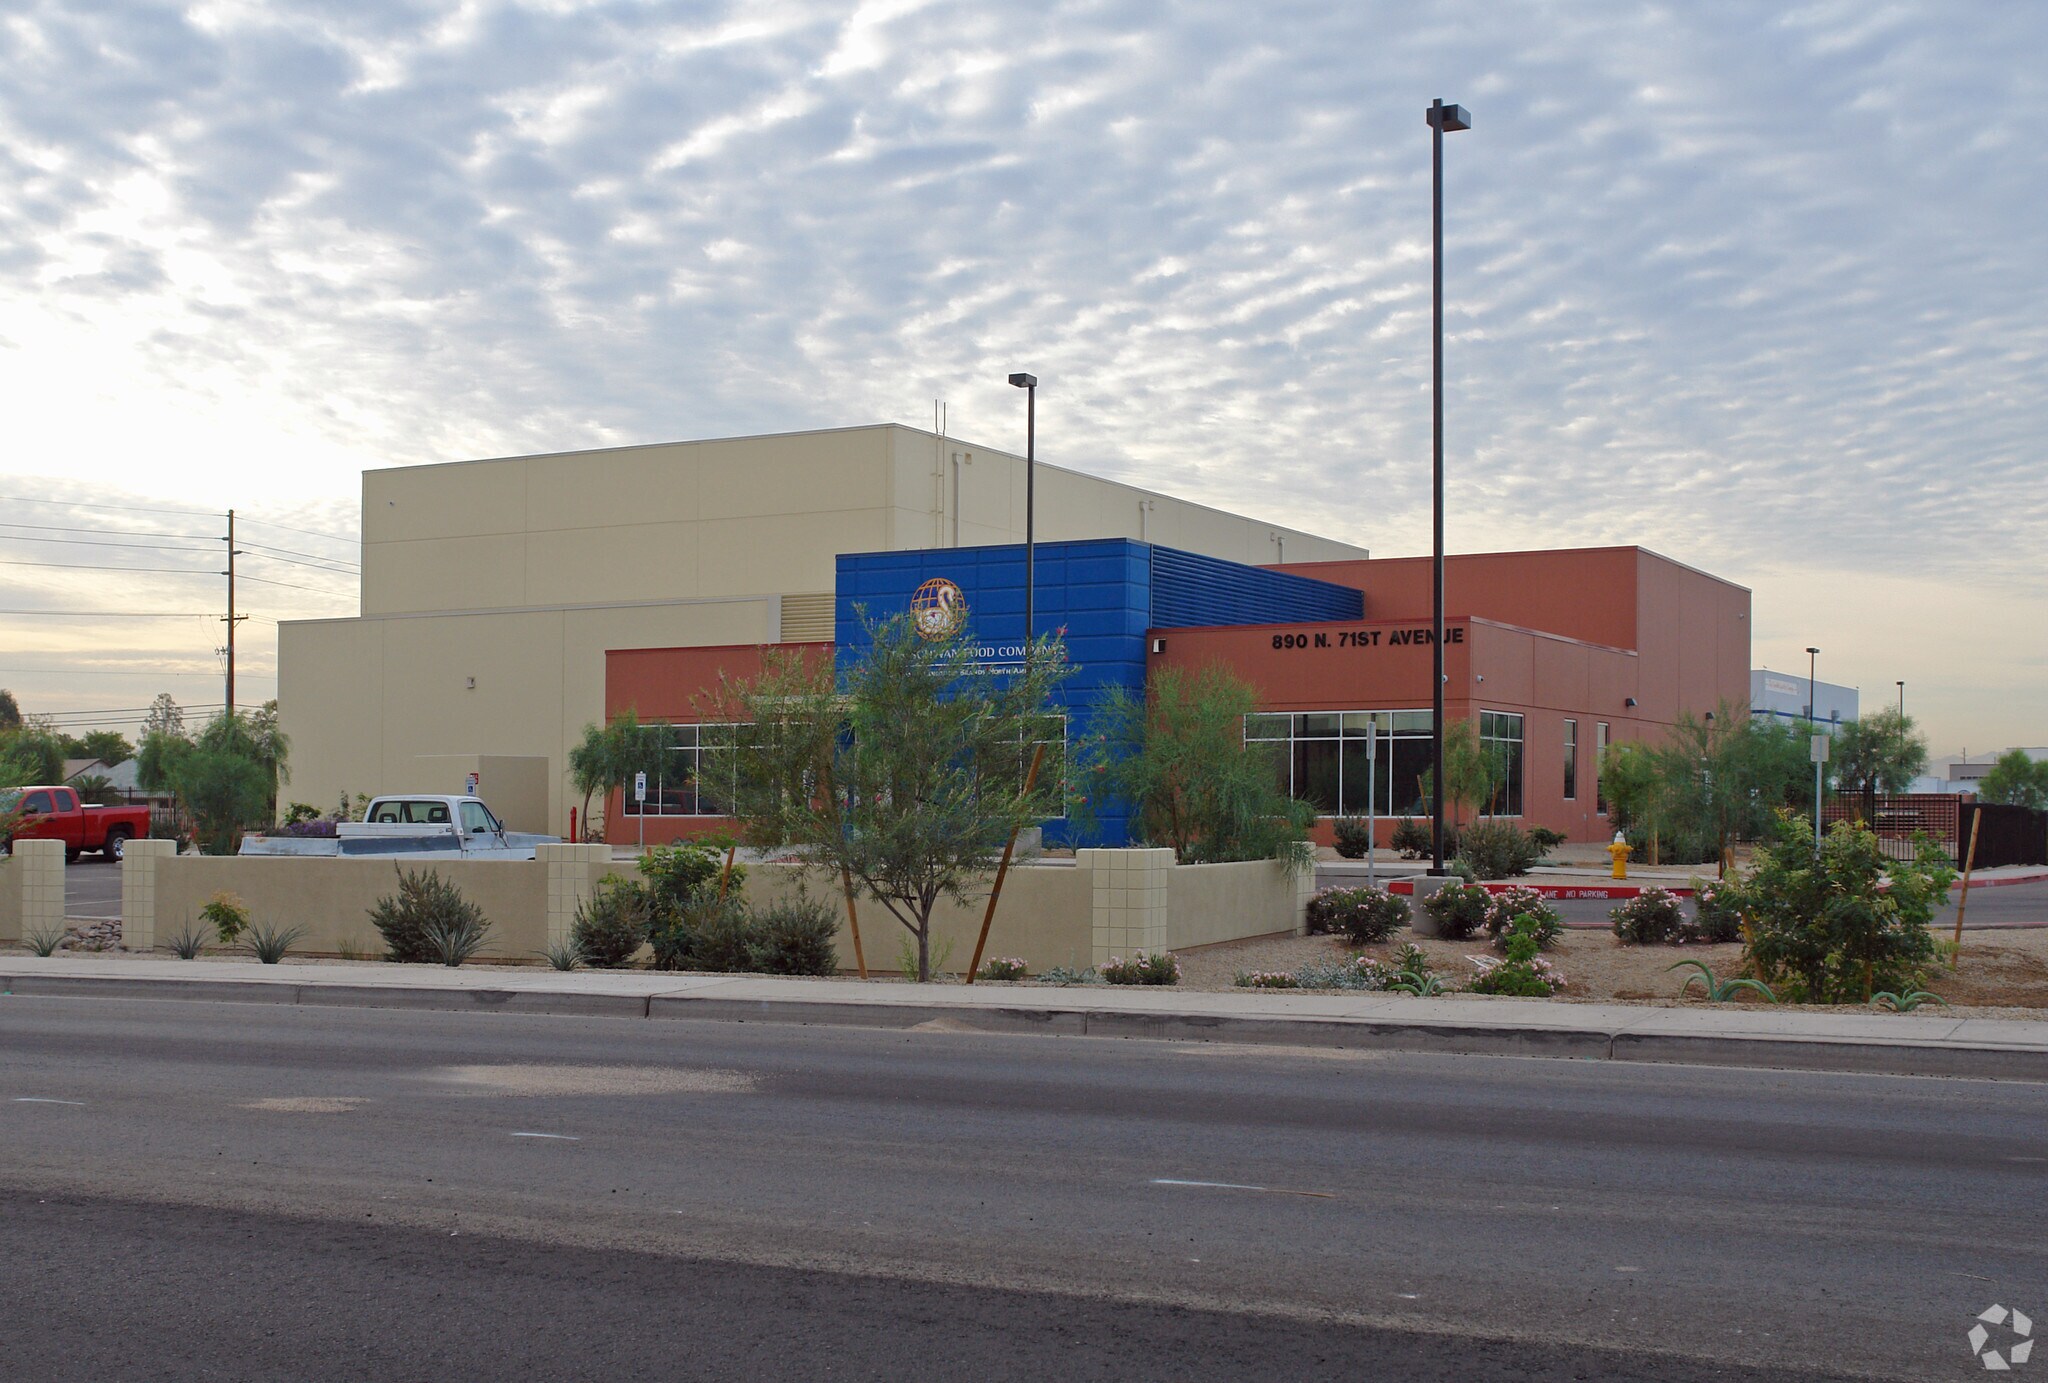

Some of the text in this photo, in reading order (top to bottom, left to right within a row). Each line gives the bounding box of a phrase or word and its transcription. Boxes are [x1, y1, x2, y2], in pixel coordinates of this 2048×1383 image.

[1272, 634, 1308, 650] 890
[1314, 632, 1331, 648] N.
[1338, 631, 1381, 647] 71ST
[963, 647, 995, 658] FOOD
[998, 644, 1058, 657] COMPAN
[1566, 890, 1576, 898] NO
[1579, 890, 1608, 899] PARKING
